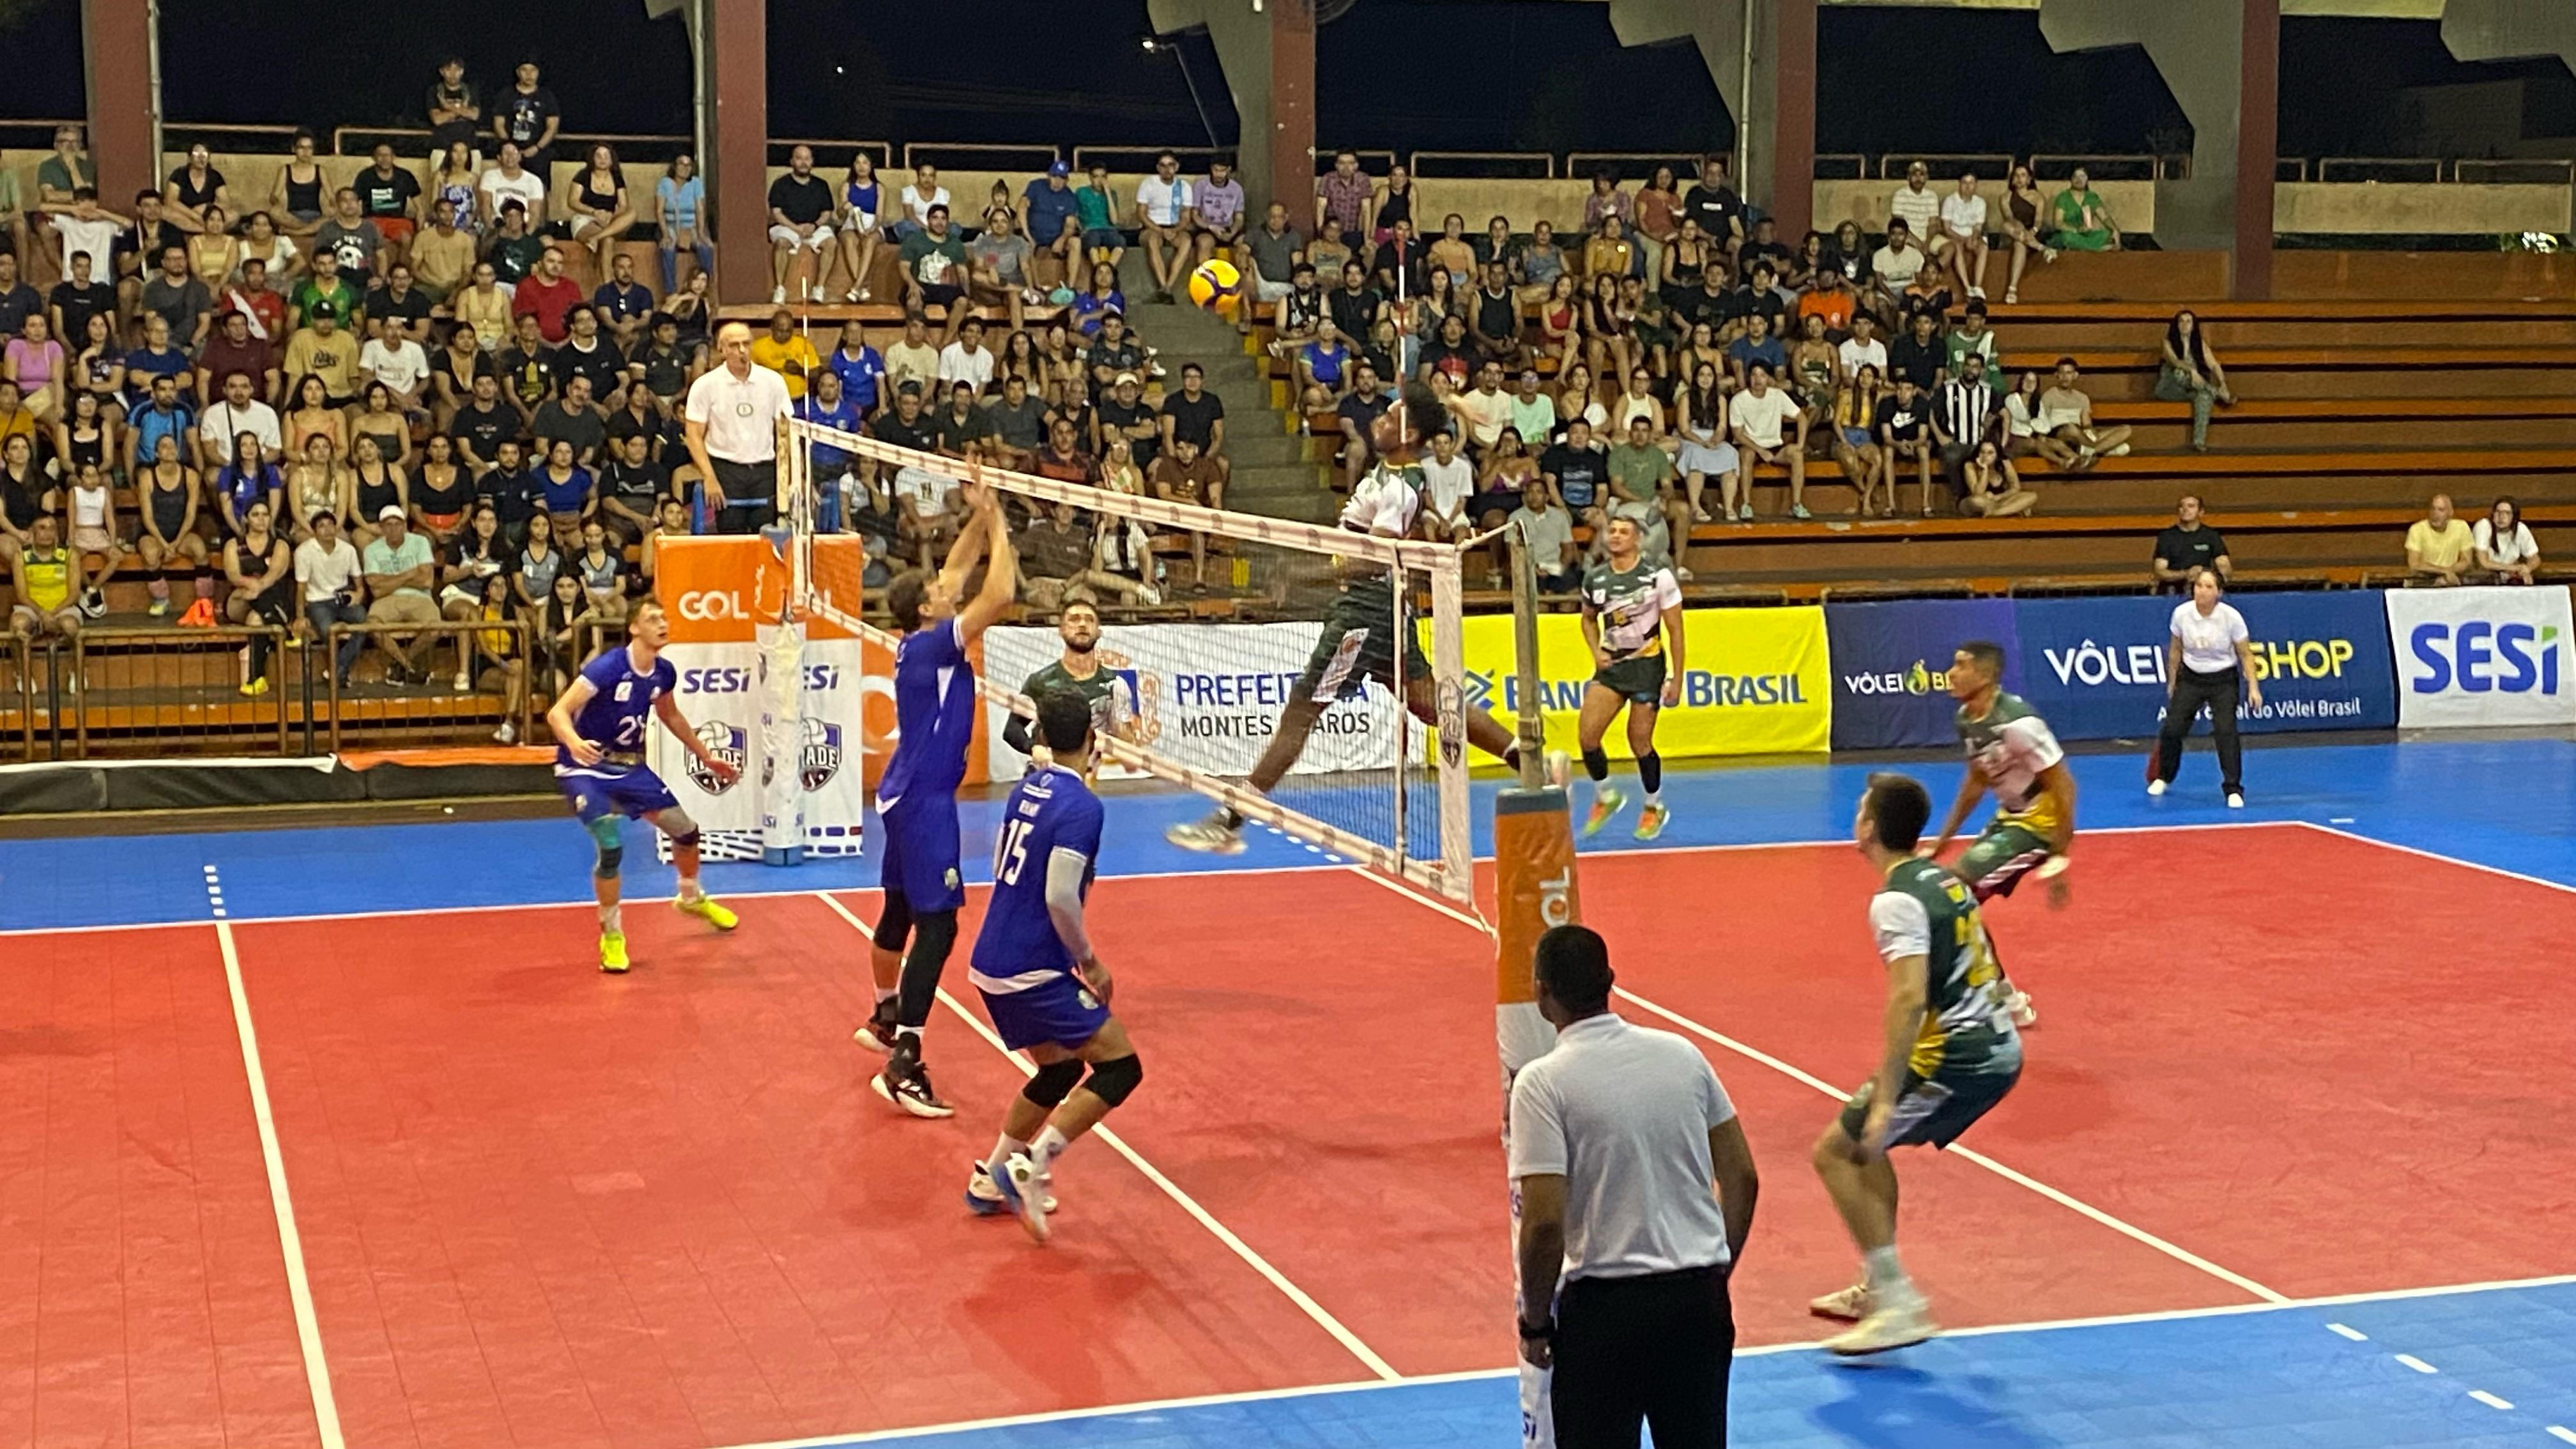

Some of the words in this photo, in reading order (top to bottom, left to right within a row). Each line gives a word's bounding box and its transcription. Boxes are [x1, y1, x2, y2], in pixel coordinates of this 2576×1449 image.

[678, 591, 749, 621] GOL
[2043, 638, 2166, 686] VÔLEI
[2249, 640, 2354, 680] SHOP
[1686, 670, 1808, 707] BRASIL
[1844, 671, 1903, 694] VÔLEI
[2274, 699, 2315, 718] Vôlei
[2318, 696, 2361, 717] Brasil
[1181, 714, 1273, 738] MONTES
[1311, 712, 1370, 735] AROS
[997, 818, 1034, 885] 15
[1538, 865, 1571, 930] OL
